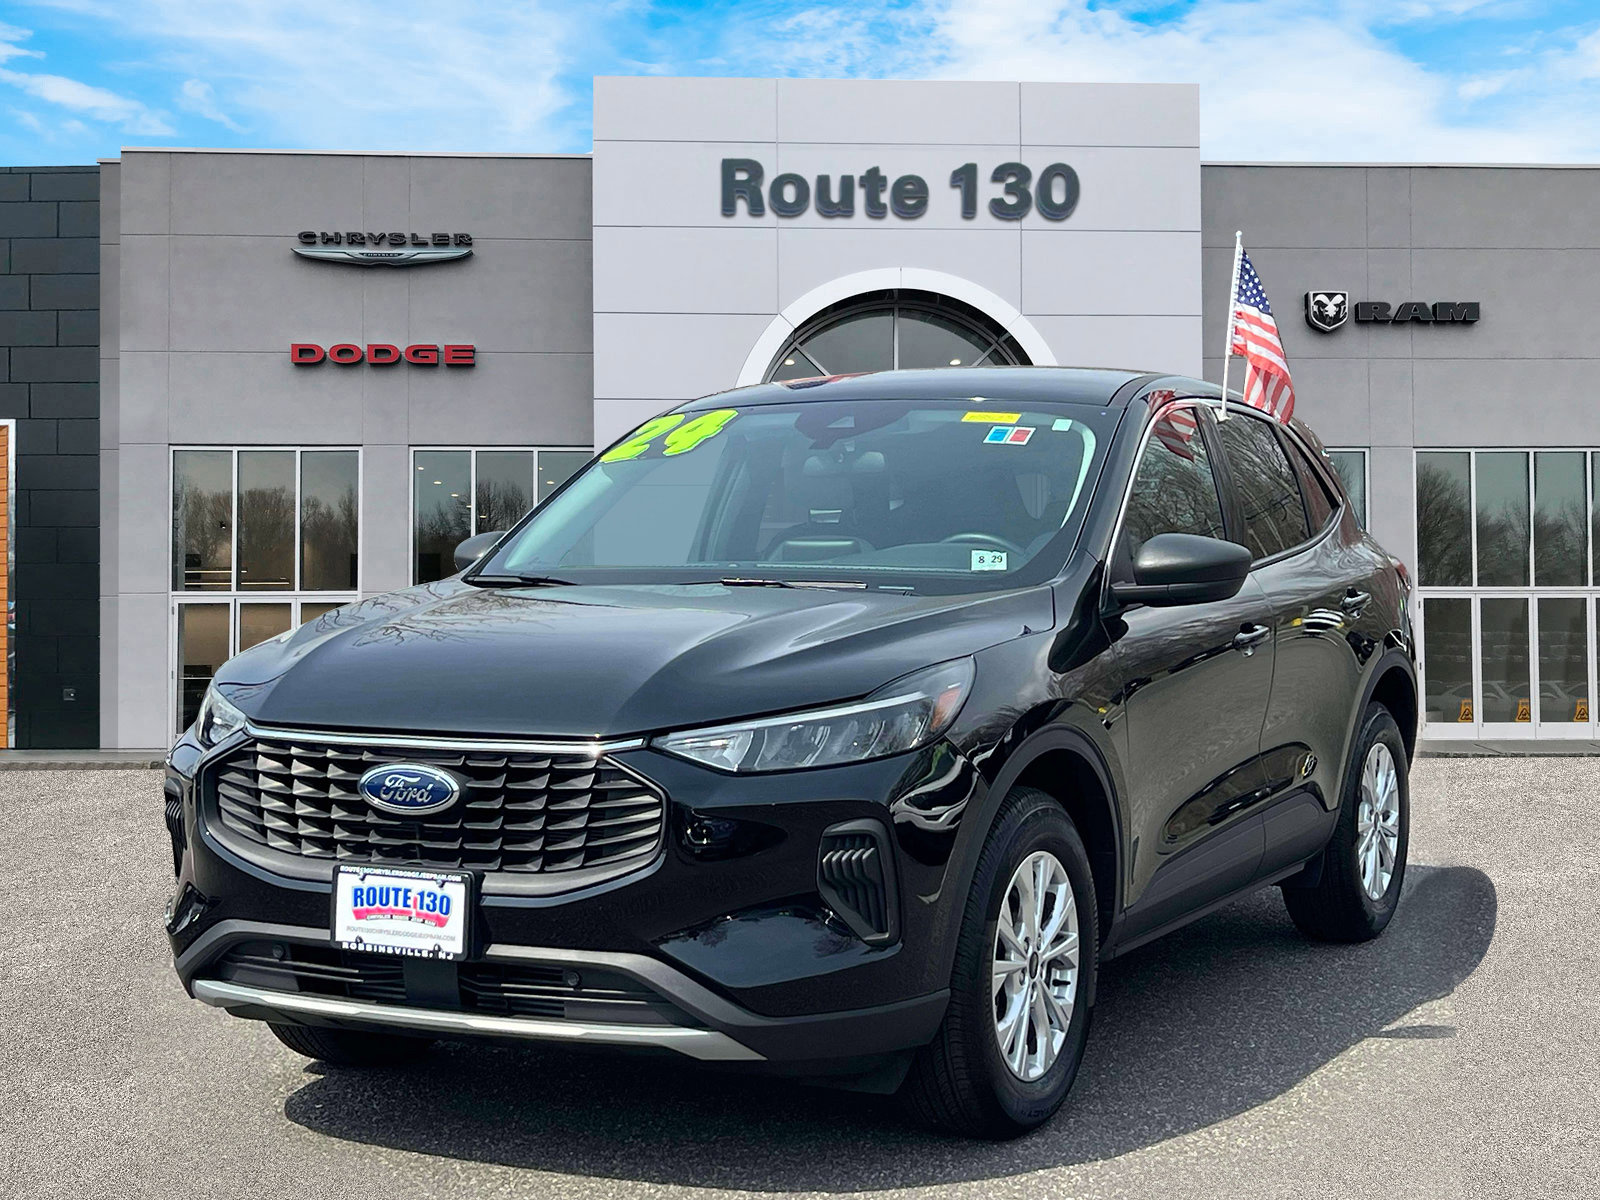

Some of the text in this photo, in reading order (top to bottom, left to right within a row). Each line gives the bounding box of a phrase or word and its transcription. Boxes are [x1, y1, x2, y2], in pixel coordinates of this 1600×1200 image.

[721, 158, 1081, 220] Route 130
[298, 231, 472, 246] CHRYSLER
[1354, 301, 1481, 324] RAM
[290, 343, 476, 366] DODGE
[978, 554, 1003, 564] 8 29
[380, 774, 434, 803] Ford
[353, 886, 451, 916] ROUTE 130
[438, 951, 454, 960] NJ
